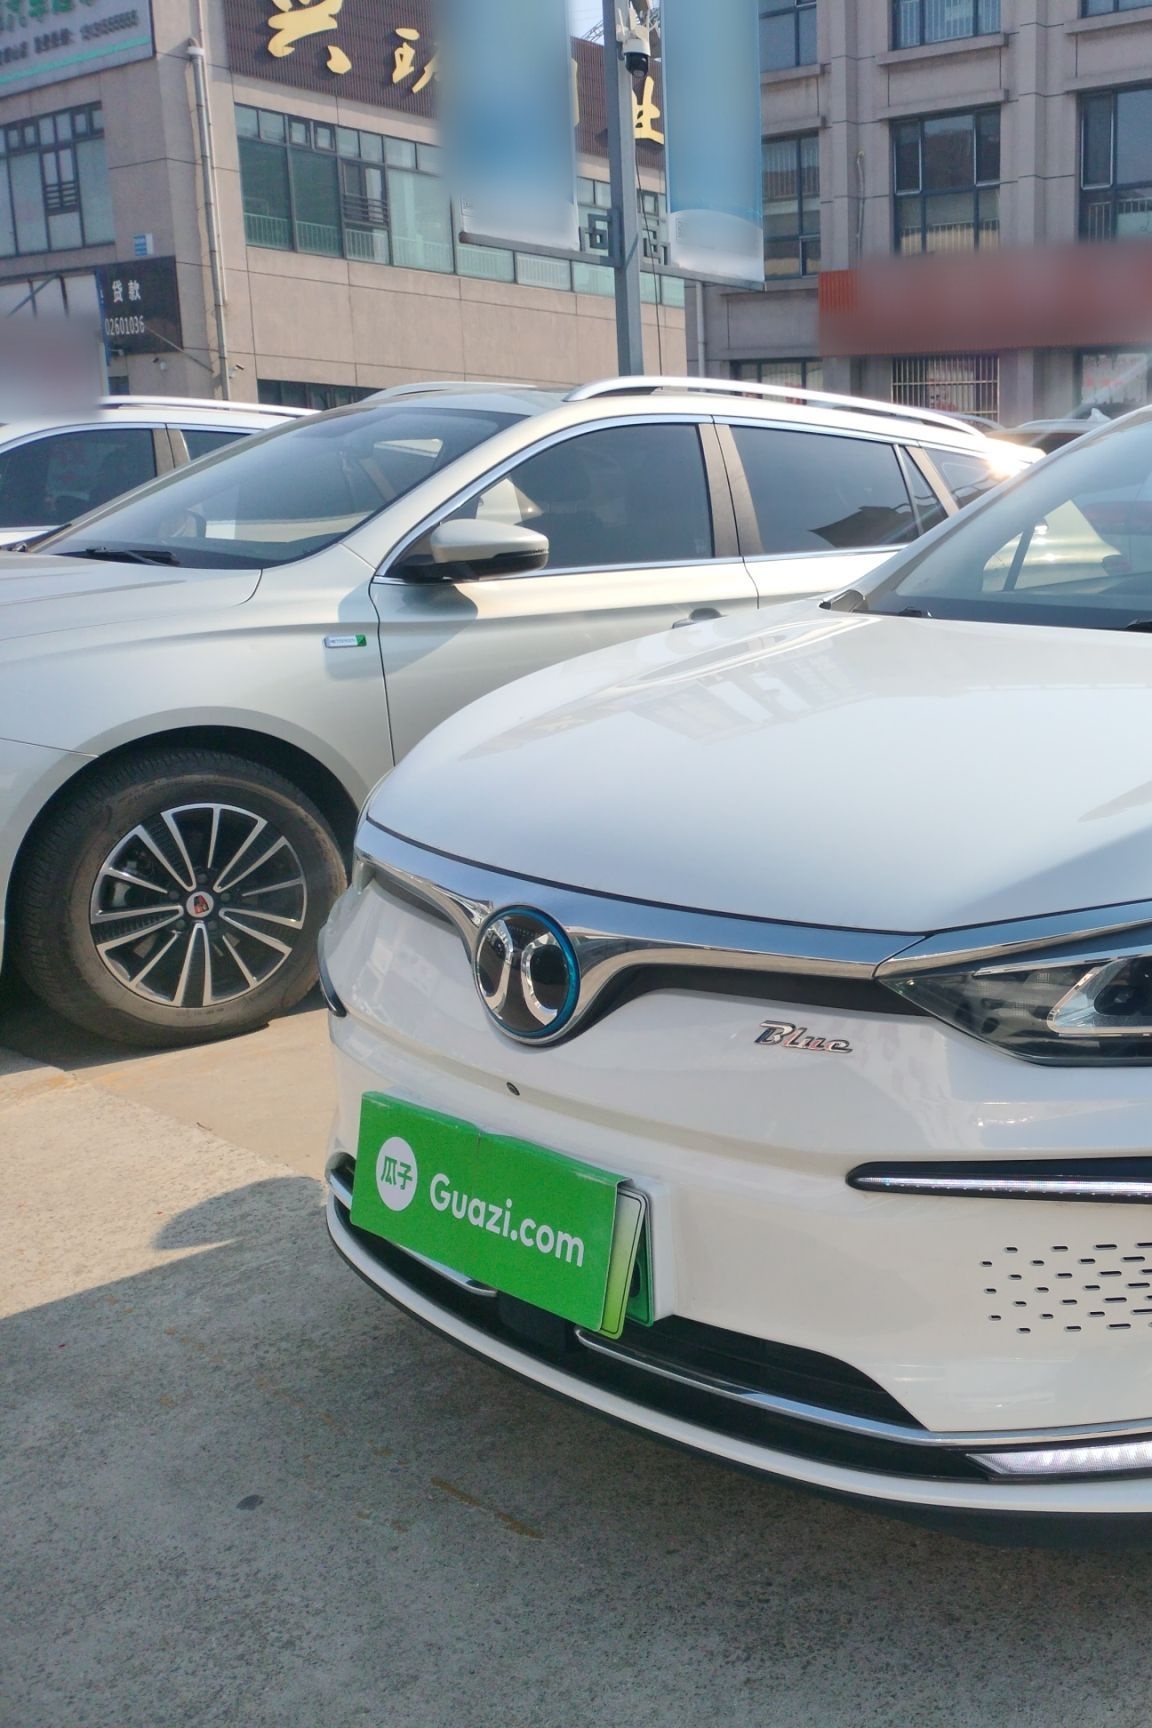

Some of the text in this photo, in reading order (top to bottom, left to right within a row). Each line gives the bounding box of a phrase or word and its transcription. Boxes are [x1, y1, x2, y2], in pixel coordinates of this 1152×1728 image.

[111, 280, 142, 303] 贷款
[754, 1020, 853, 1053] Blue
[380, 1155, 413, 1191] 瓜子
[429, 1172, 585, 1268] Guazi.com
